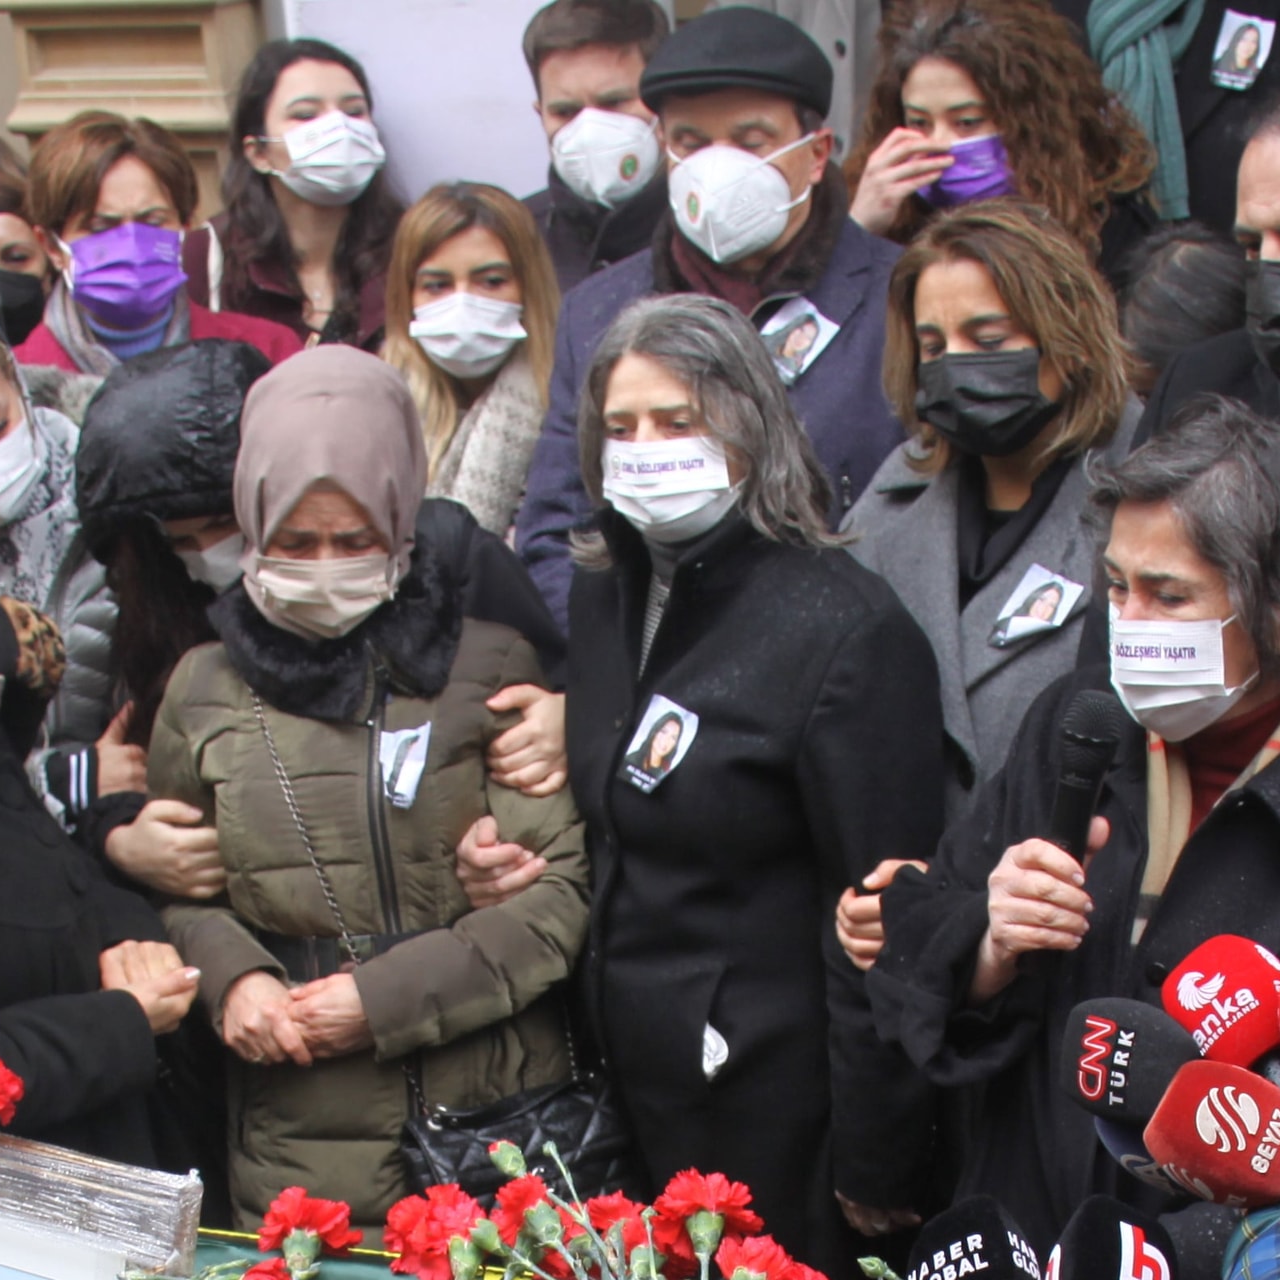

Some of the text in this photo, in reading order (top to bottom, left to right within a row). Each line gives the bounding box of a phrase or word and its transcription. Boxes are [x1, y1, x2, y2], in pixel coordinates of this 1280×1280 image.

[1115, 642, 1196, 662] SÖZLEŞMESİ YAŞATIR
[1192, 988, 1256, 1048] anka
[1078, 1014, 1118, 1101] CNN
[1109, 1029, 1136, 1106] TÜRK
